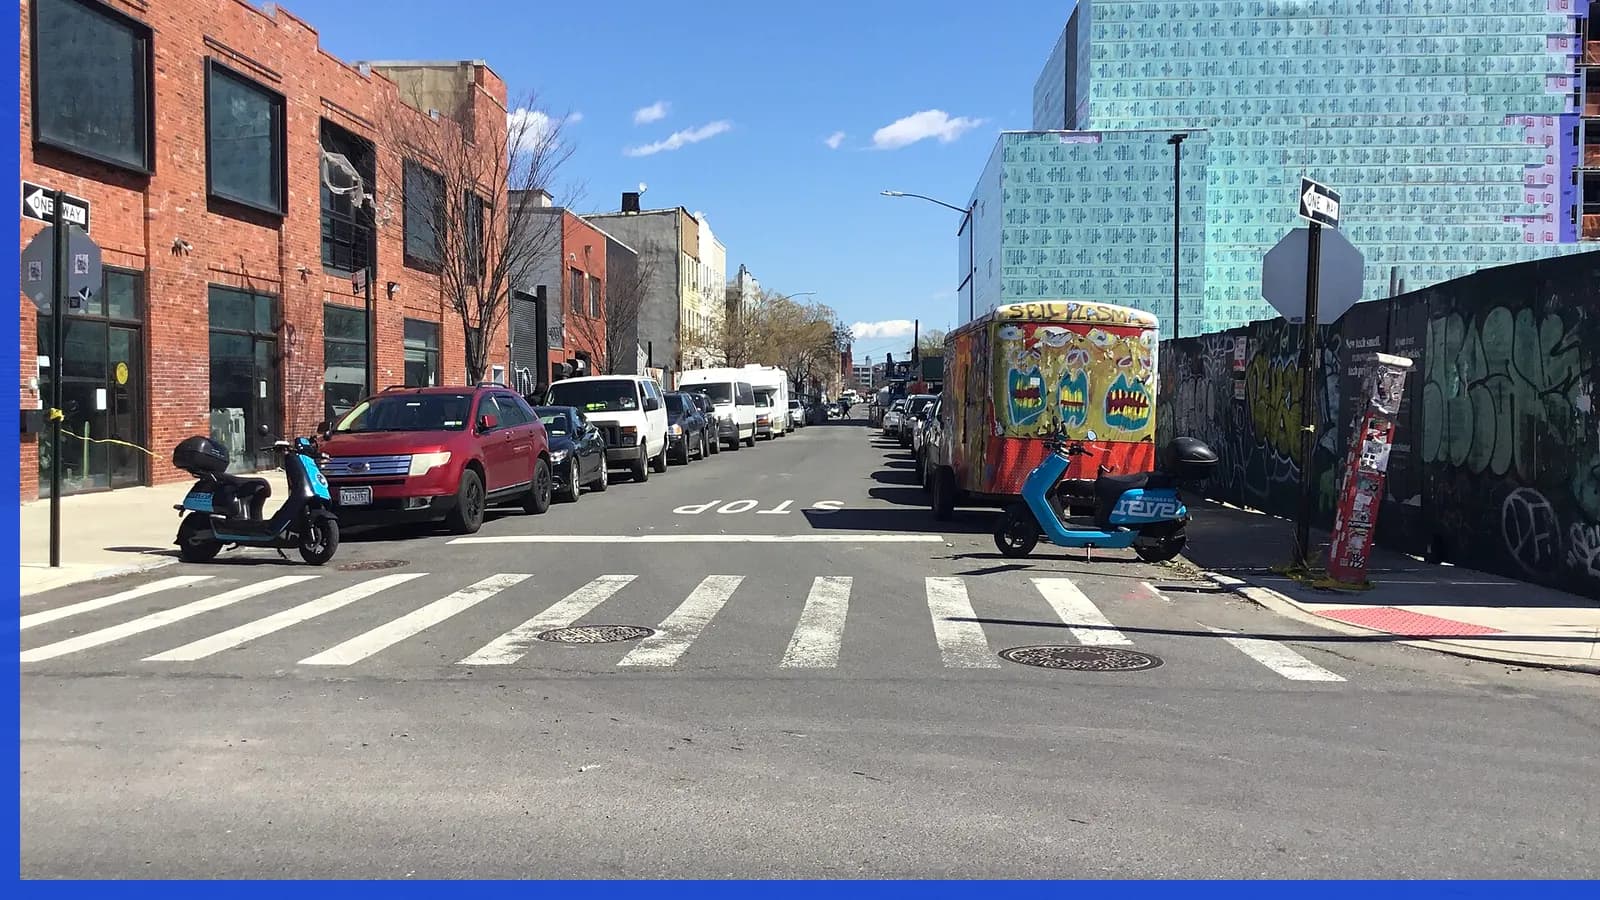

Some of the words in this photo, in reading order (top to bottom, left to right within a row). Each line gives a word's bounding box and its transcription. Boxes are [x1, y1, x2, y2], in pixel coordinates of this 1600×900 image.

[33, 196, 54, 214] ONE
[62, 202, 82, 221] WAY
[1307, 192, 1321, 210] ONE
[672, 499, 845, 515] STOP
